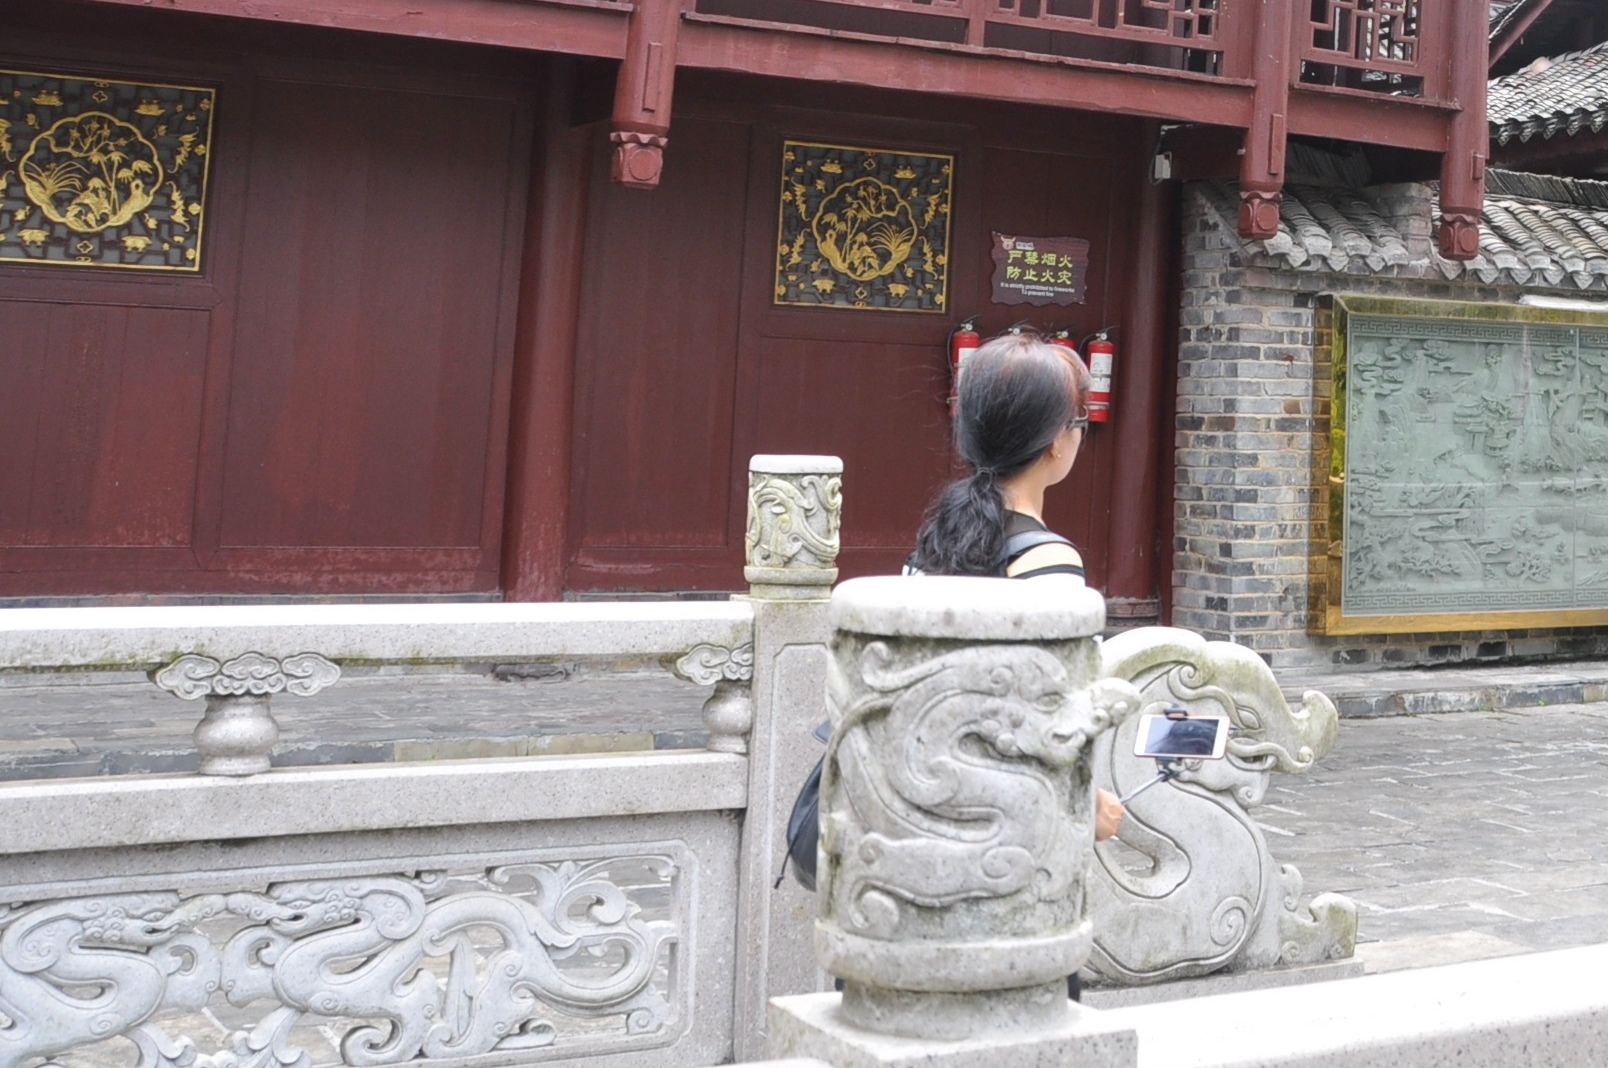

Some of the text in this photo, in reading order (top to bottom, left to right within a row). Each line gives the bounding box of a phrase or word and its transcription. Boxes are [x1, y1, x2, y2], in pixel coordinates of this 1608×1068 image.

[1007, 250, 1073, 268] 严禁烟火
[1006, 265, 1072, 285] 防止火灾
